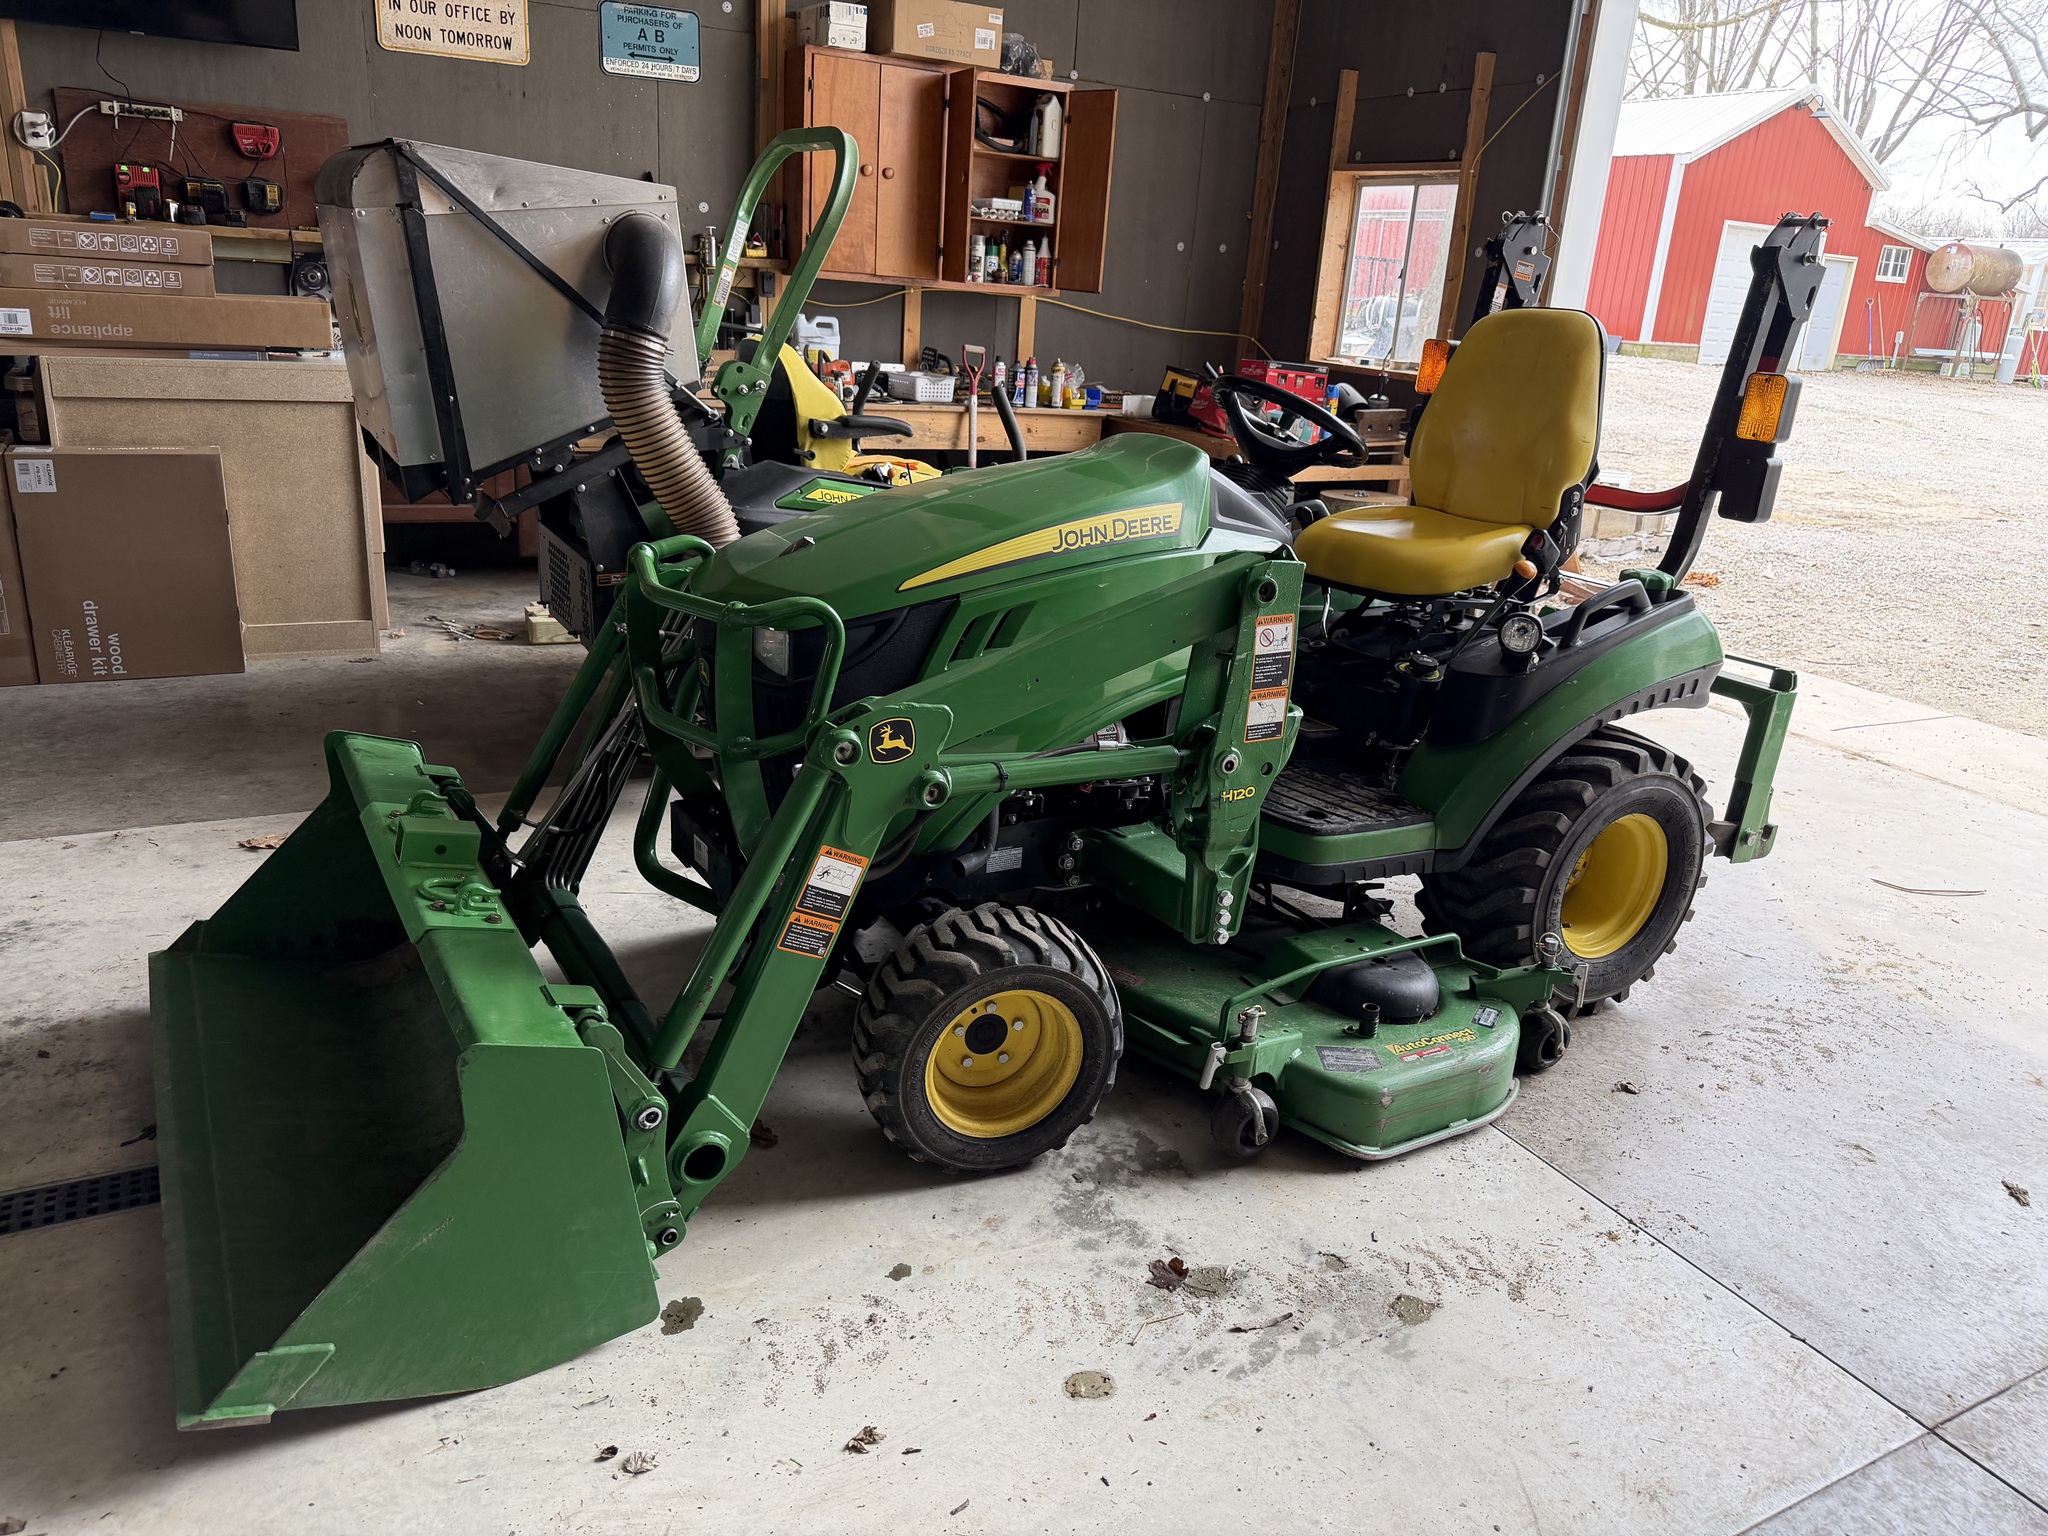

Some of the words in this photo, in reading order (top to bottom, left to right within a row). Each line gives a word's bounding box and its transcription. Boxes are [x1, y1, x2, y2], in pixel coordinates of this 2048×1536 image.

[389, 0, 401, 11] IN
[410, 0, 436, 15] OUR
[445, 3, 491, 23] OFFICE
[500, 11, 515, 25] BY
[623, 6, 657, 17] PARKING
[661, 11, 677, 20] FOR
[617, 14, 669, 28] PURCHASERS
[673, 22, 683, 30] OF
[395, 23, 431, 41] NOON
[440, 28, 512, 51] TOMORROW
[637, 28, 648, 41] A
[655, 29, 665, 43] B
[623, 42, 656, 53] PERMITS
[660, 47, 679, 55] ONLY
[606, 58, 639, 68] ENFORCED
[642, 62, 649, 70] 24
[682, 66, 697, 75] DAYS
[166, 240, 172, 248] 5
[169, 274, 175, 282] 5
[48, 306, 70, 320] lift
[51, 323, 133, 338] appliance
[817, 490, 849, 503] JOHN
[1052, 523, 1108, 551] JOHN
[1112, 514, 1173, 539] DEERE
[82, 600, 102, 653] drawer
[1263, 615, 1293, 625] WARNING
[51, 629, 68, 675] CABINETRY
[107, 633, 128, 674] wood
[91, 657, 108, 676] kit
[1257, 690, 1286, 699] WARNING
[1221, 786, 1256, 802] H120
[833, 851, 863, 865] WARNING
[803, 917, 834, 931] WARNING
[1393, 1028, 1475, 1055] AutoConnect
